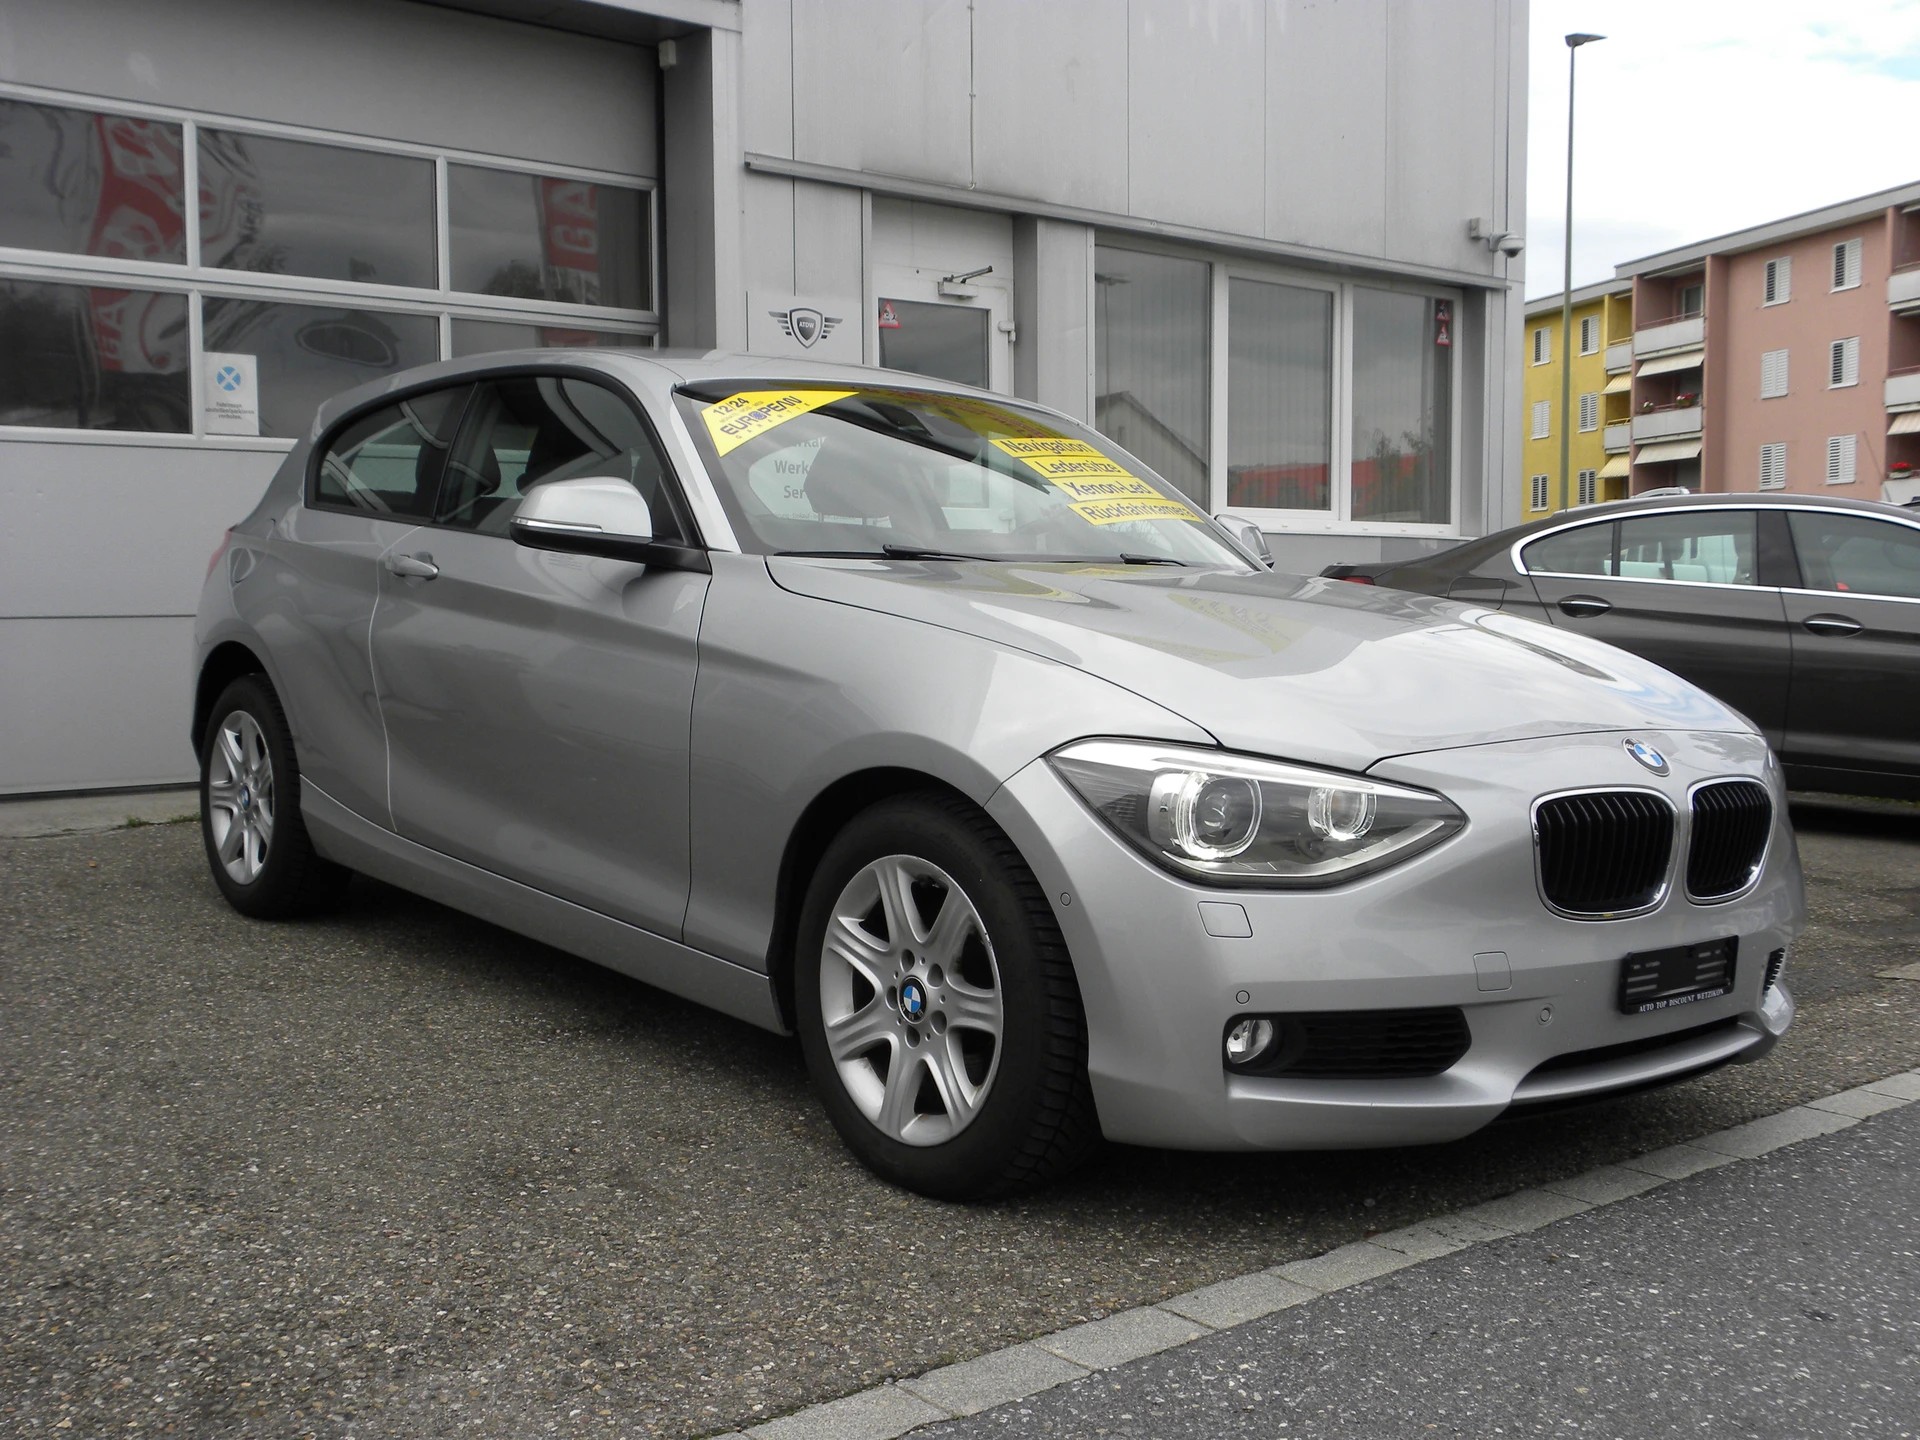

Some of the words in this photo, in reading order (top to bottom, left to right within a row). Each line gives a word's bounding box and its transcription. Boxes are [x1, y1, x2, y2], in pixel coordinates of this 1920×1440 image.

[713, 397, 750, 416] 12/24
[720, 395, 803, 435] EUROPEAN
[1000, 439, 1095, 456] Navigation
[1034, 460, 1122, 474] Ledersitze
[1064, 481, 1153, 496] Xenon-Led
[1640, 1002, 1655, 1012] AUTO
[1656, 1000, 1667, 1009] TOP
[1669, 994, 1695, 1007] DISCOUNT
[1697, 988, 1724, 1000] WETZIKON
